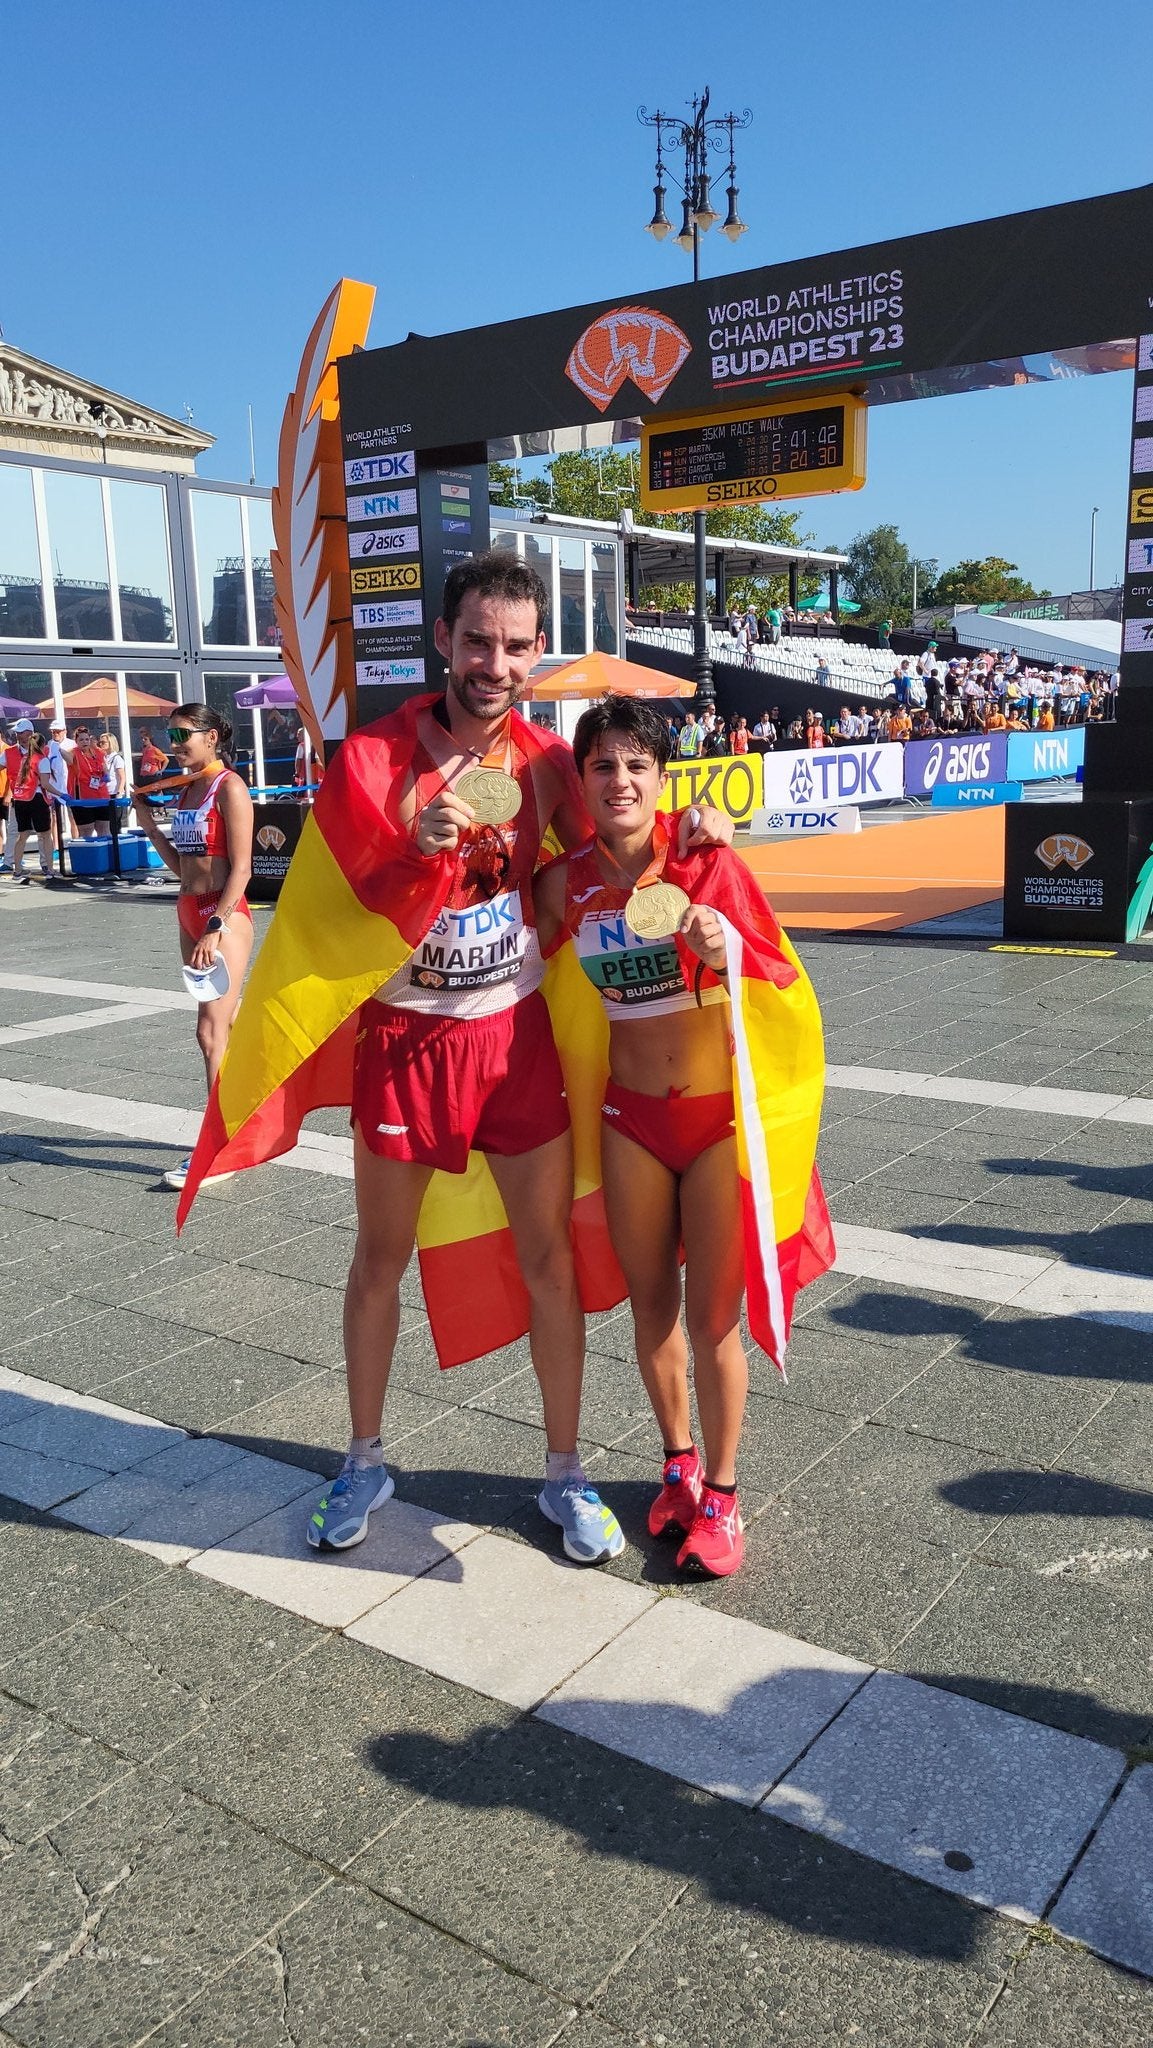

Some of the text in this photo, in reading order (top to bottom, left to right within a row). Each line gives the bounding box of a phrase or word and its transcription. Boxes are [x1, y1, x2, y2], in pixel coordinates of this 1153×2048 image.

[708, 270, 903, 325] WORLD ATHLETICS
[708, 296, 903, 350] CHAMPIONSHIPS
[711, 324, 904, 379] BUDAPEST 23
[346, 423, 412, 442] WORLD ATHLETICS
[702, 417, 784, 441] 35KM RACE WALK
[772, 425, 837, 451] 2:41:42
[360, 435, 398, 449] PARTNERS
[364, 455, 410, 479] TDK
[653, 461, 661, 469] 31
[689, 473, 714, 485] LEYVER
[707, 478, 777, 502] SEIKO
[363, 496, 400, 515] NTN
[354, 567, 418, 590] SEIKO
[1131, 586, 1152, 596] CITY
[360, 607, 385, 623] TBS
[1009, 603, 1059, 619] WITNESS
[376, 636, 394, 644] WORLD
[395, 635, 422, 643] ATHLETICS
[946, 742, 991, 782] asics
[1034, 738, 1069, 772] NTN
[813, 750, 883, 800] TDK
[958, 788, 995, 801] NTN
[173, 810, 198, 826] NTN
[784, 811, 838, 828] TDK
[1024, 877, 1104, 887] WORLD ATHLETICS
[1024, 885, 1104, 896] CHAMPIONSHIPS
[1024, 894, 1104, 906] BUDAPEST 23
[449, 896, 516, 938] TDK
[421, 932, 518, 969] MARTÍN
[448, 962, 521, 986] BUDAPEST 23
[625, 977, 685, 998] BUDAPES
